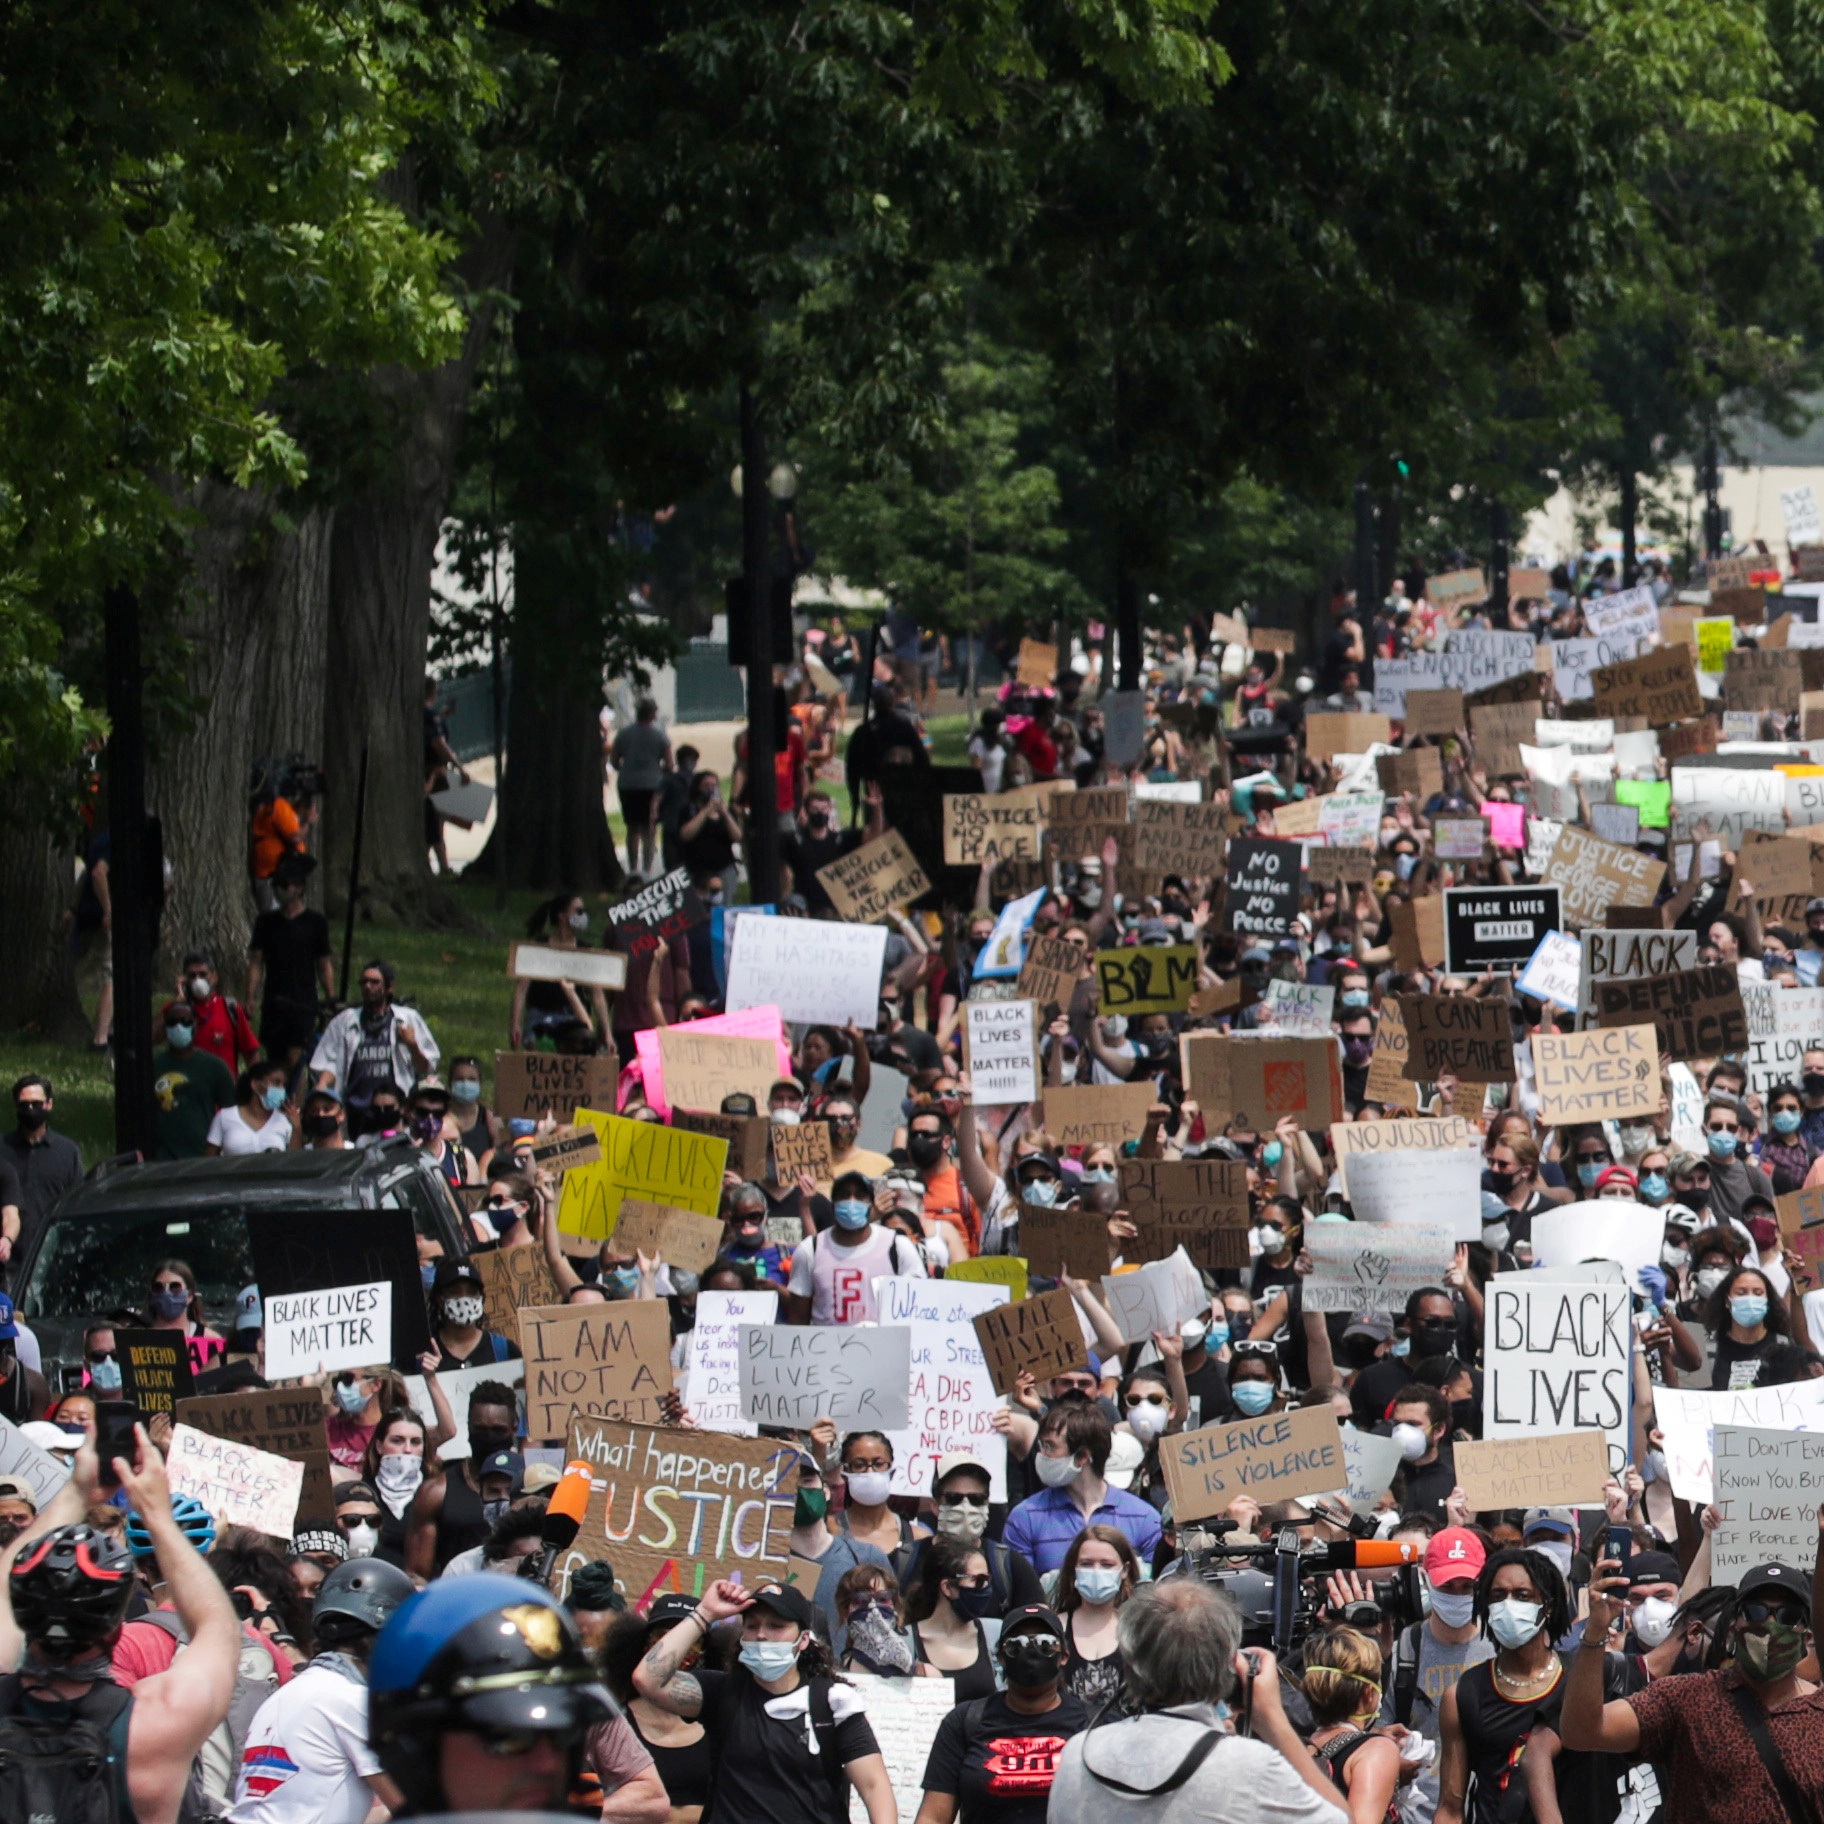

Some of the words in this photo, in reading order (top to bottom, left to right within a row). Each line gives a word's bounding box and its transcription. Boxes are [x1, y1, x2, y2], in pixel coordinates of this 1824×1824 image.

[1248, 852, 1280, 873] NO
[608, 866, 692, 926] PROSECUTE
[1230, 872, 1290, 896] Justice
[637, 899, 673, 926] THE
[1247, 895, 1276, 913] NO
[1459, 902, 1501, 917] BLACK
[1510, 900, 1545, 915] LIVES
[1233, 911, 1286, 934] Peace
[1480, 923, 1529, 937] MATTER
[973, 1007, 1026, 1023] BLACK
[978, 1029, 1021, 1044] LIVES
[972, 1056, 1031, 1071] MATTER
[273, 1297, 320, 1324] BLACK
[327, 1288, 380, 1316] LIVES
[1494, 1291, 1627, 1358] BLACK
[290, 1319, 375, 1357] MATTER
[527, 1321, 561, 1363] I
[575, 1321, 637, 1361] AM
[750, 1330, 870, 1360] BLACK
[538, 1367, 614, 1396] NOT
[636, 1364, 660, 1393] A
[752, 1366, 854, 1387] LIVES
[751, 1389, 881, 1420] MATTER
[1493, 1369, 1625, 1429] LIVES
[1716, 1430, 1739, 1458] I
[1747, 1437, 1797, 1459] DON'T
[575, 1425, 636, 1469] What
[645, 1430, 778, 1491] happened
[1204, 1467, 1227, 1494] IS
[1719, 1470, 1760, 1490] KNOW
[592, 1485, 797, 1562] USTICE
[1719, 1500, 1737, 1522] I
[1748, 1502, 1796, 1522] LOVE
[1716, 1531, 1740, 1547] IF
[1748, 1531, 1799, 1547] PEOPLE
[1716, 1553, 1749, 1566] HATE
[1759, 1552, 1785, 1565] FOR
